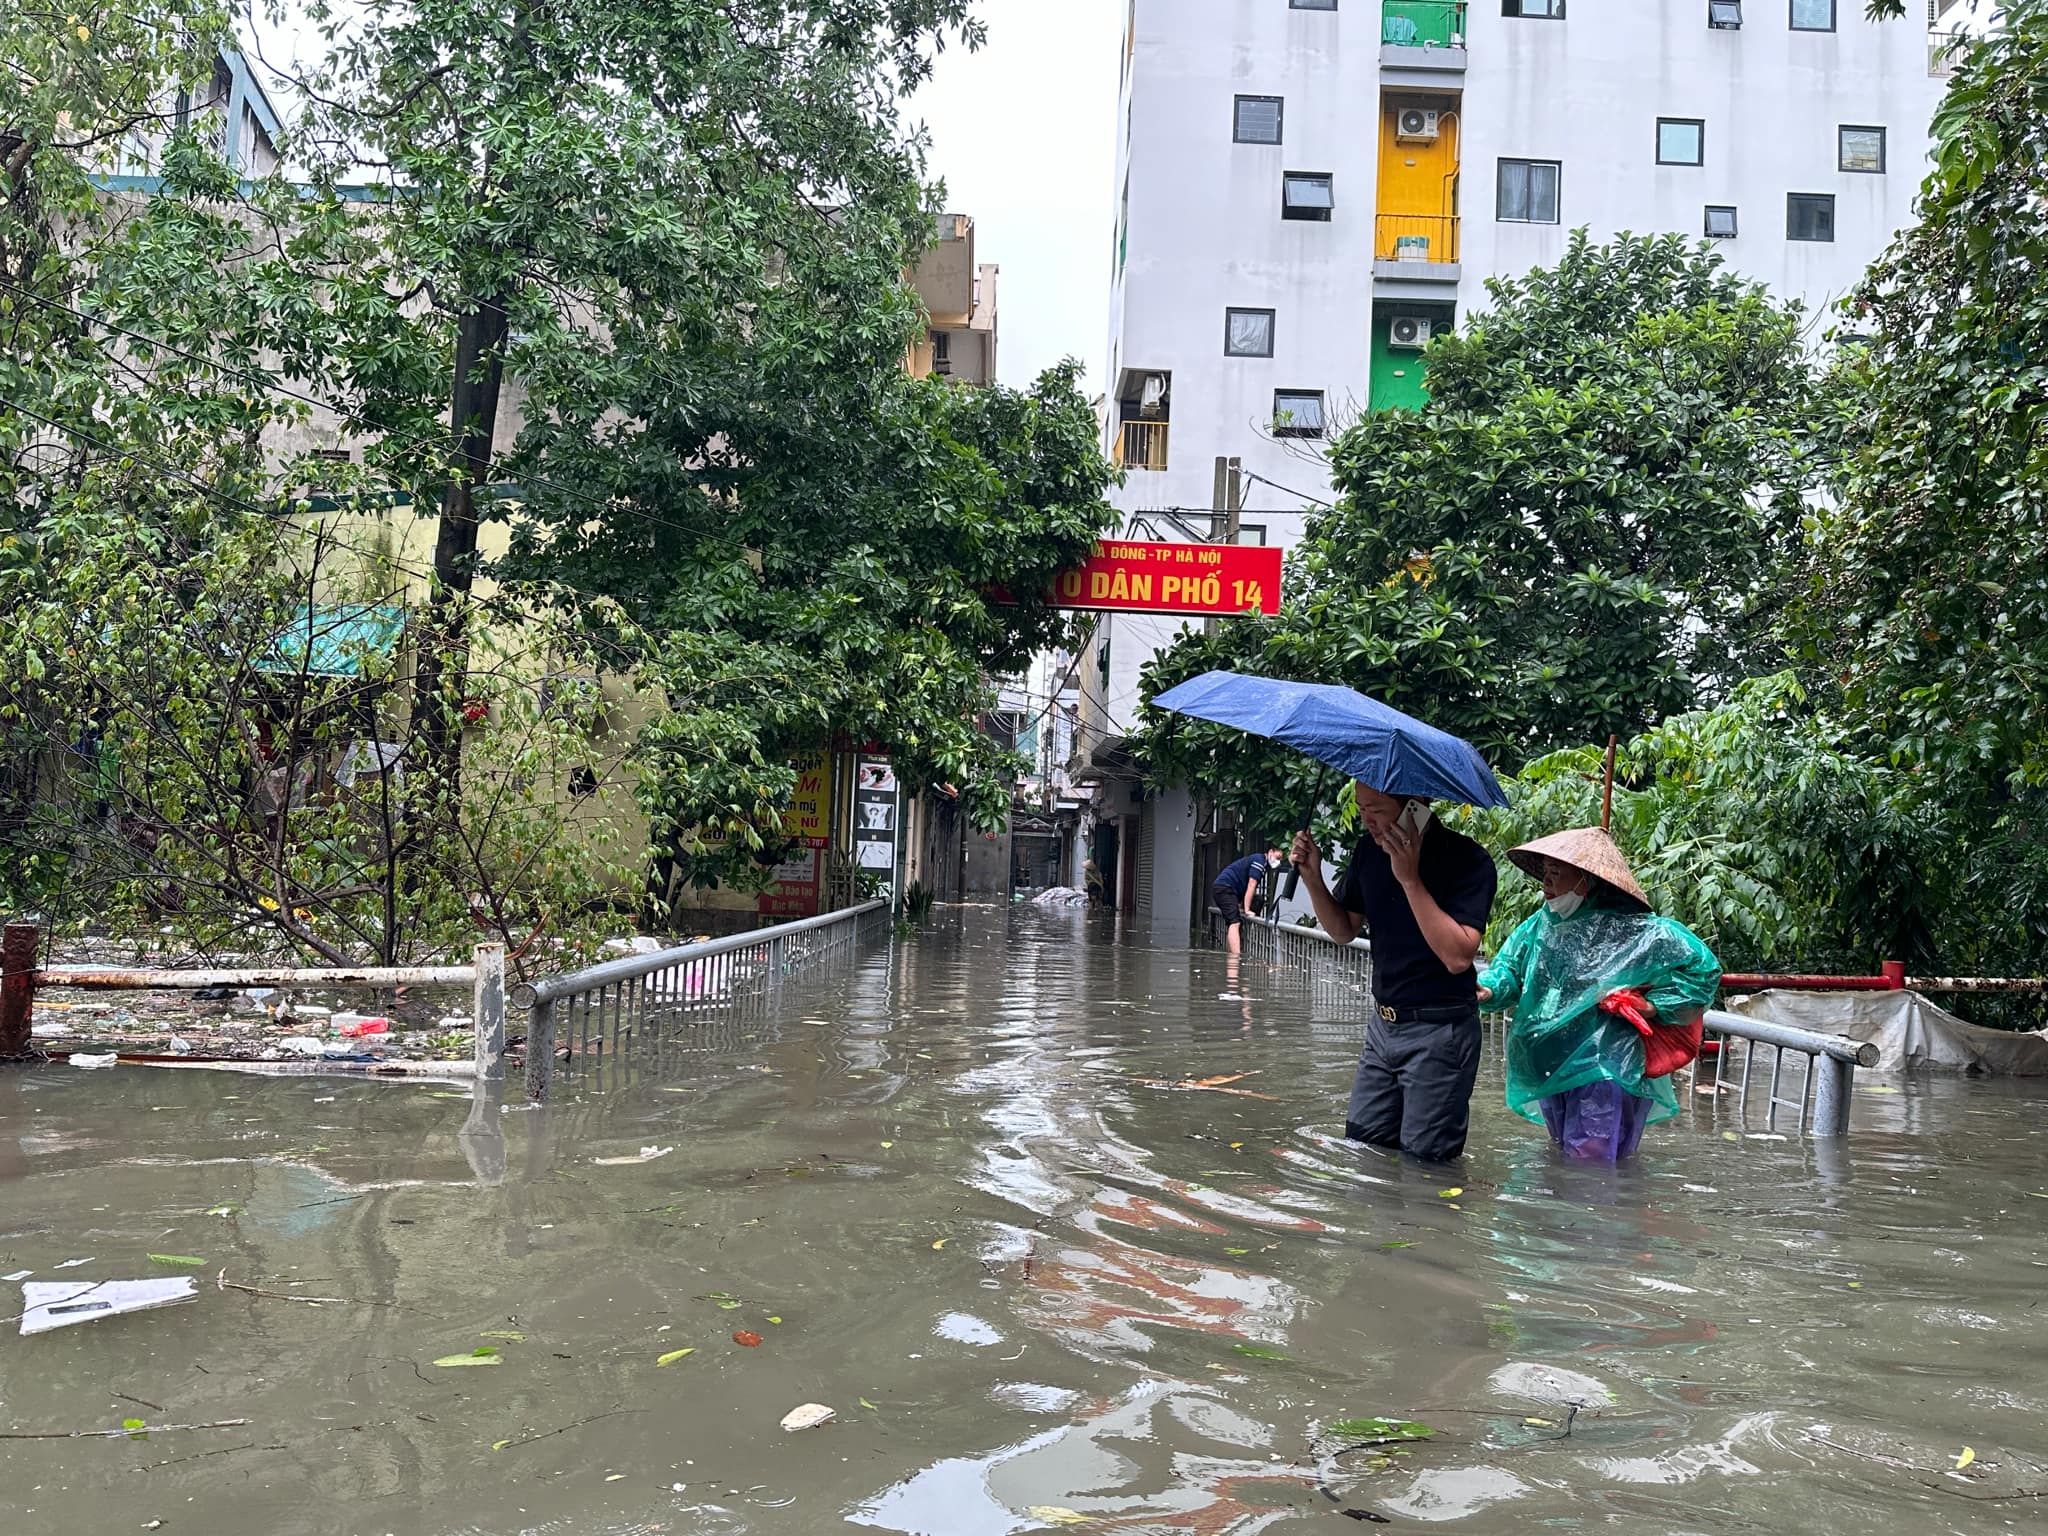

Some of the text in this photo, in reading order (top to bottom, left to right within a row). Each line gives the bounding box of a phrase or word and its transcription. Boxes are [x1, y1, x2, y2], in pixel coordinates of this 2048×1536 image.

[1175, 547, 1194, 563] HÀ
[1198, 549, 1222, 567] NỘI
[1090, 567, 1152, 601] DÂN
[1162, 569, 1223, 605] PHỐ
[1231, 579, 1263, 608] 14
